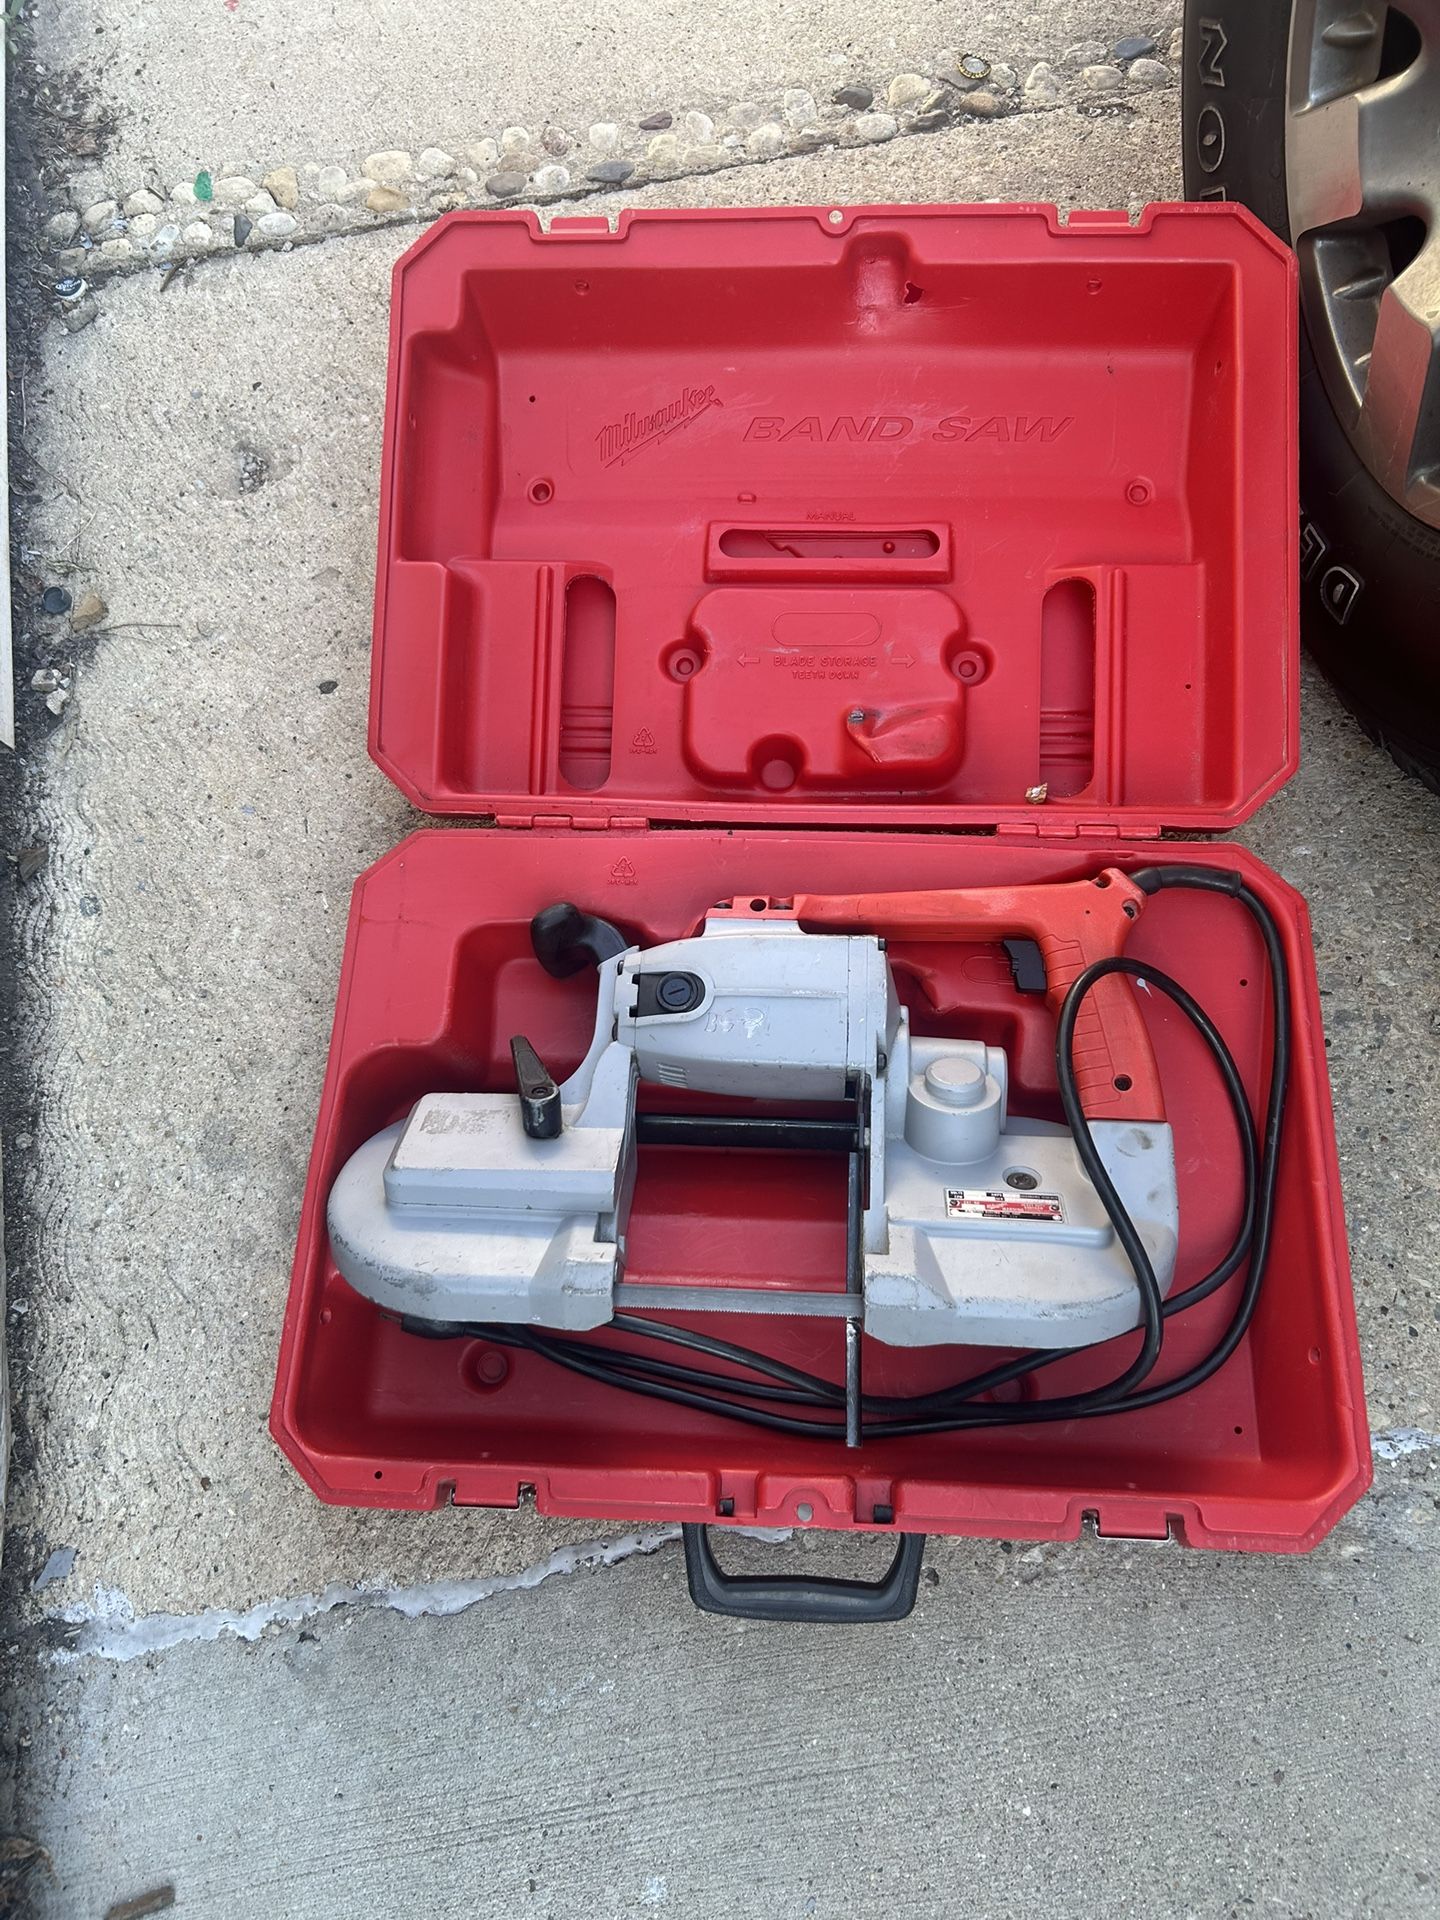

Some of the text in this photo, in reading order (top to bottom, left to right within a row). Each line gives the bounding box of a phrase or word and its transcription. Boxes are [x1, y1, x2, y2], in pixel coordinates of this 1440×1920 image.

[594, 384, 725, 464] Milwaukee
[742, 415, 1077, 443] BAND SAW
[806, 511, 857, 522] MANUAL
[773, 655, 878, 668] BLADE STORAGE
[791, 670, 860, 680] TEETH DOWN
